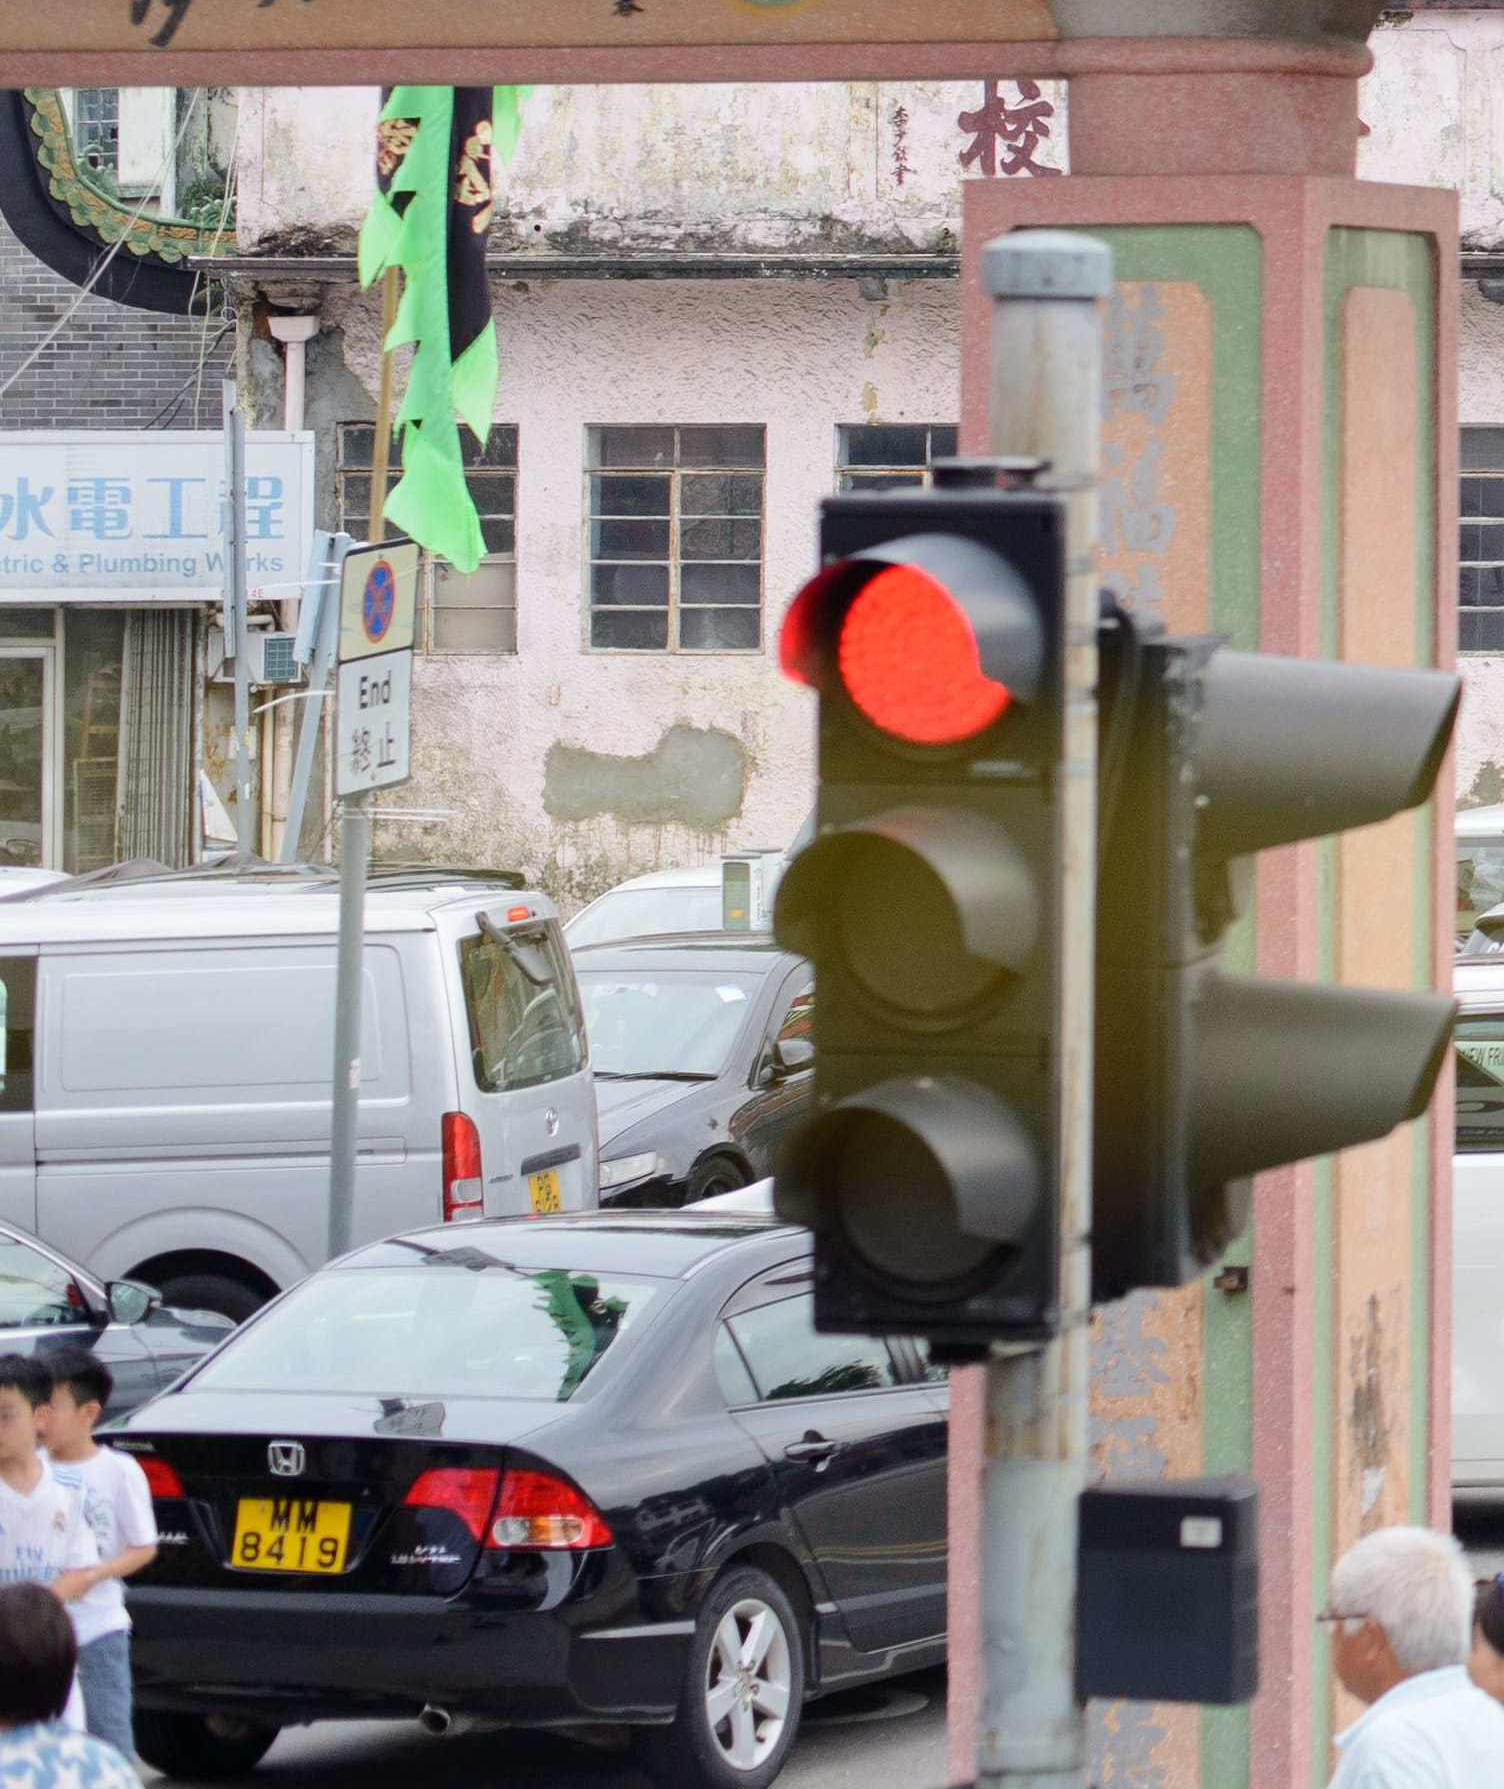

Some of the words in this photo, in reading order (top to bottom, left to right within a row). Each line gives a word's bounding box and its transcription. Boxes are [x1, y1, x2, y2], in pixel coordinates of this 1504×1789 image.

[51, 553, 70, 574] &
[78, 552, 197, 578] Plumbing
[205, 552, 285, 573] Wrks
[359, 671, 393, 709] End
[350, 722, 396, 775] 終止
[270, 1498, 319, 1533] MM
[241, 1532, 340, 1568] 8419
